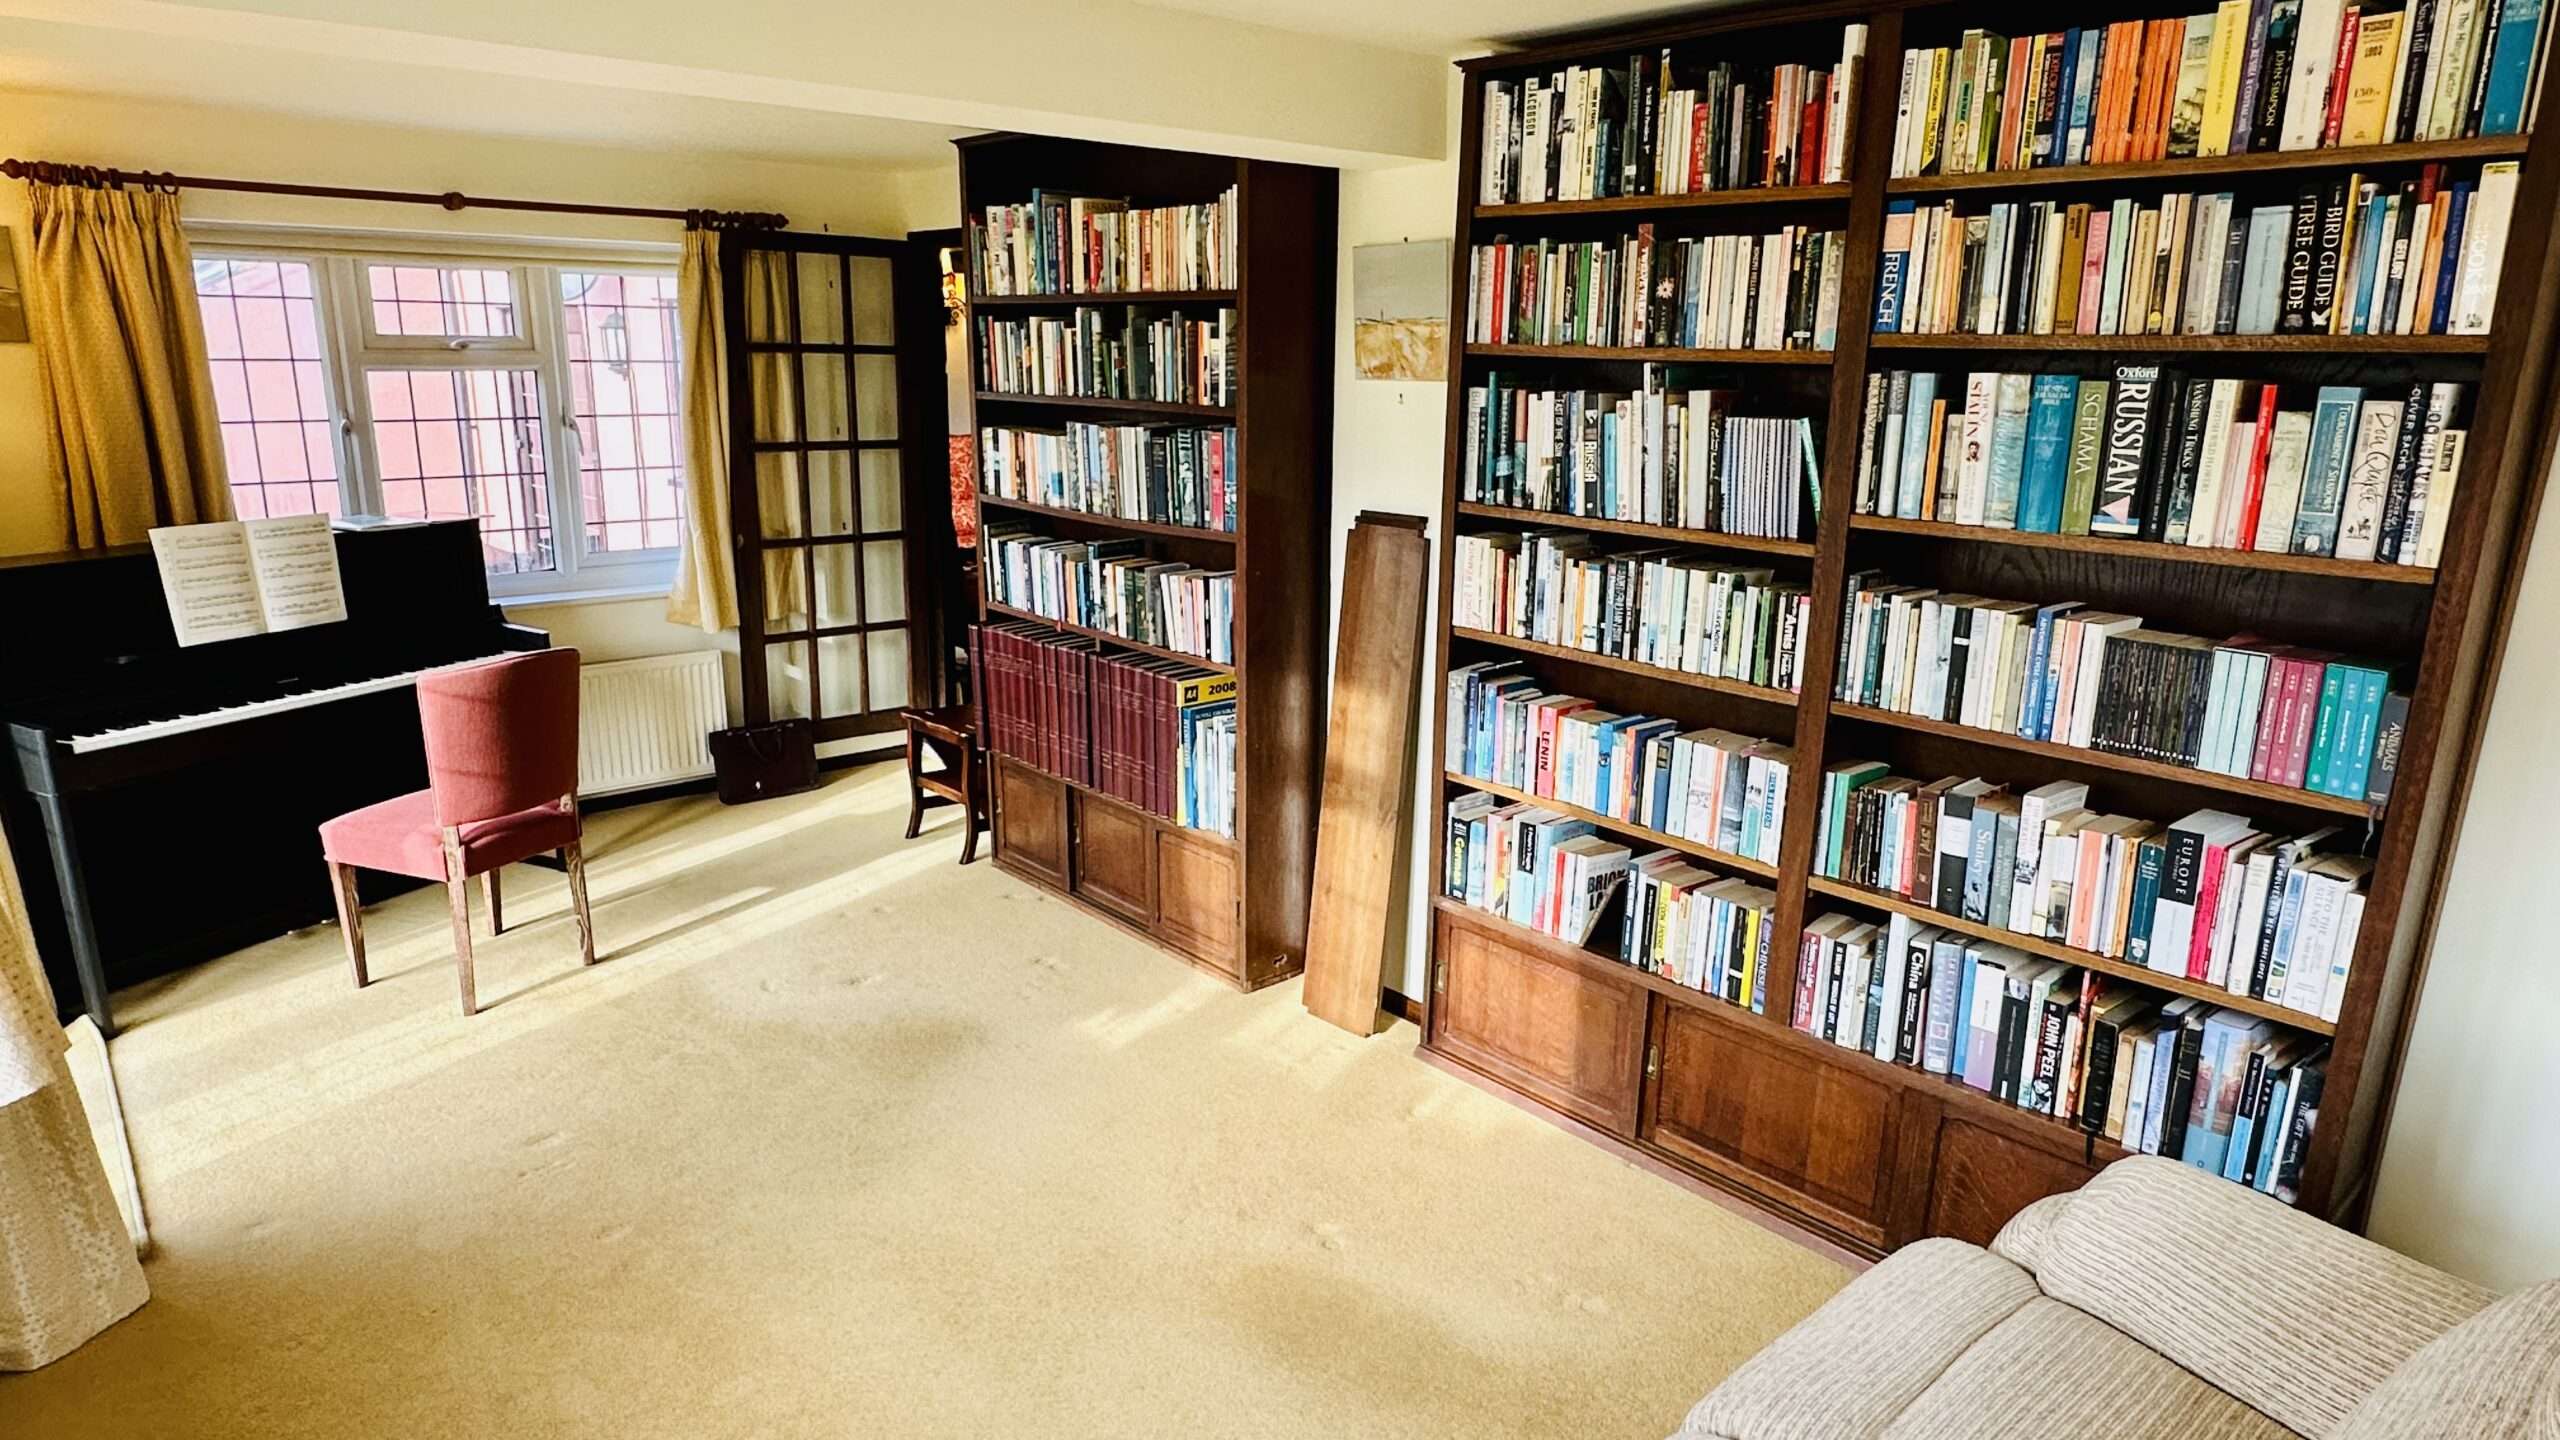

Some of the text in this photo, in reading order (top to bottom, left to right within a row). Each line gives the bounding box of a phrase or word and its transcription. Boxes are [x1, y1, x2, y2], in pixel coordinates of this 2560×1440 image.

[2456, 12, 2470, 30] The
[2263, 50, 2287, 127] JOHN SIMPSON
[2444, 66, 2460, 98] Factor
[2284, 199, 2320, 311] TREE GUIDE
[2312, 206, 2345, 307] BIRD GUIDE
[2388, 238, 2409, 280] GEOLOGY
[1877, 252, 1902, 322] FRENCH
[2116, 366, 2159, 379] Oxford
[1466, 390, 1481, 453] Bill Bryson
[1554, 399, 1565, 415] EAST
[1965, 382, 1986, 438] STALIN
[2186, 382, 2207, 431] VANISHING
[1553, 442, 1565, 457] SUN
[1554, 427, 1563, 440] THE
[2072, 393, 2102, 475] SCHAMA
[2102, 381, 2153, 496] RUSSIAN
[2368, 408, 2399, 449] Don
[2395, 387, 2423, 470] OLIVER SACKS
[1583, 440, 1598, 482] RUSSIA
[2181, 433, 2200, 469] TRACKS
[1781, 613, 1798, 650] Amis
[1208, 681, 1237, 696] 2008
[1537, 730, 1552, 772] LENIN
[2379, 721, 2403, 772] ANIMALS
[1450, 836, 1466, 885] German
[2173, 837, 2197, 896] EUROPE
[2306, 886, 2327, 929] SILENCE
[2317, 884, 2338, 936] INTO THE
[1753, 941, 1771, 987] CHINESE
[1906, 951, 1926, 989] China
[2043, 1013, 2062, 1046] JOHN
[2038, 1047, 2057, 1078] PEEL
[2297, 1101, 2310, 1117] THE
